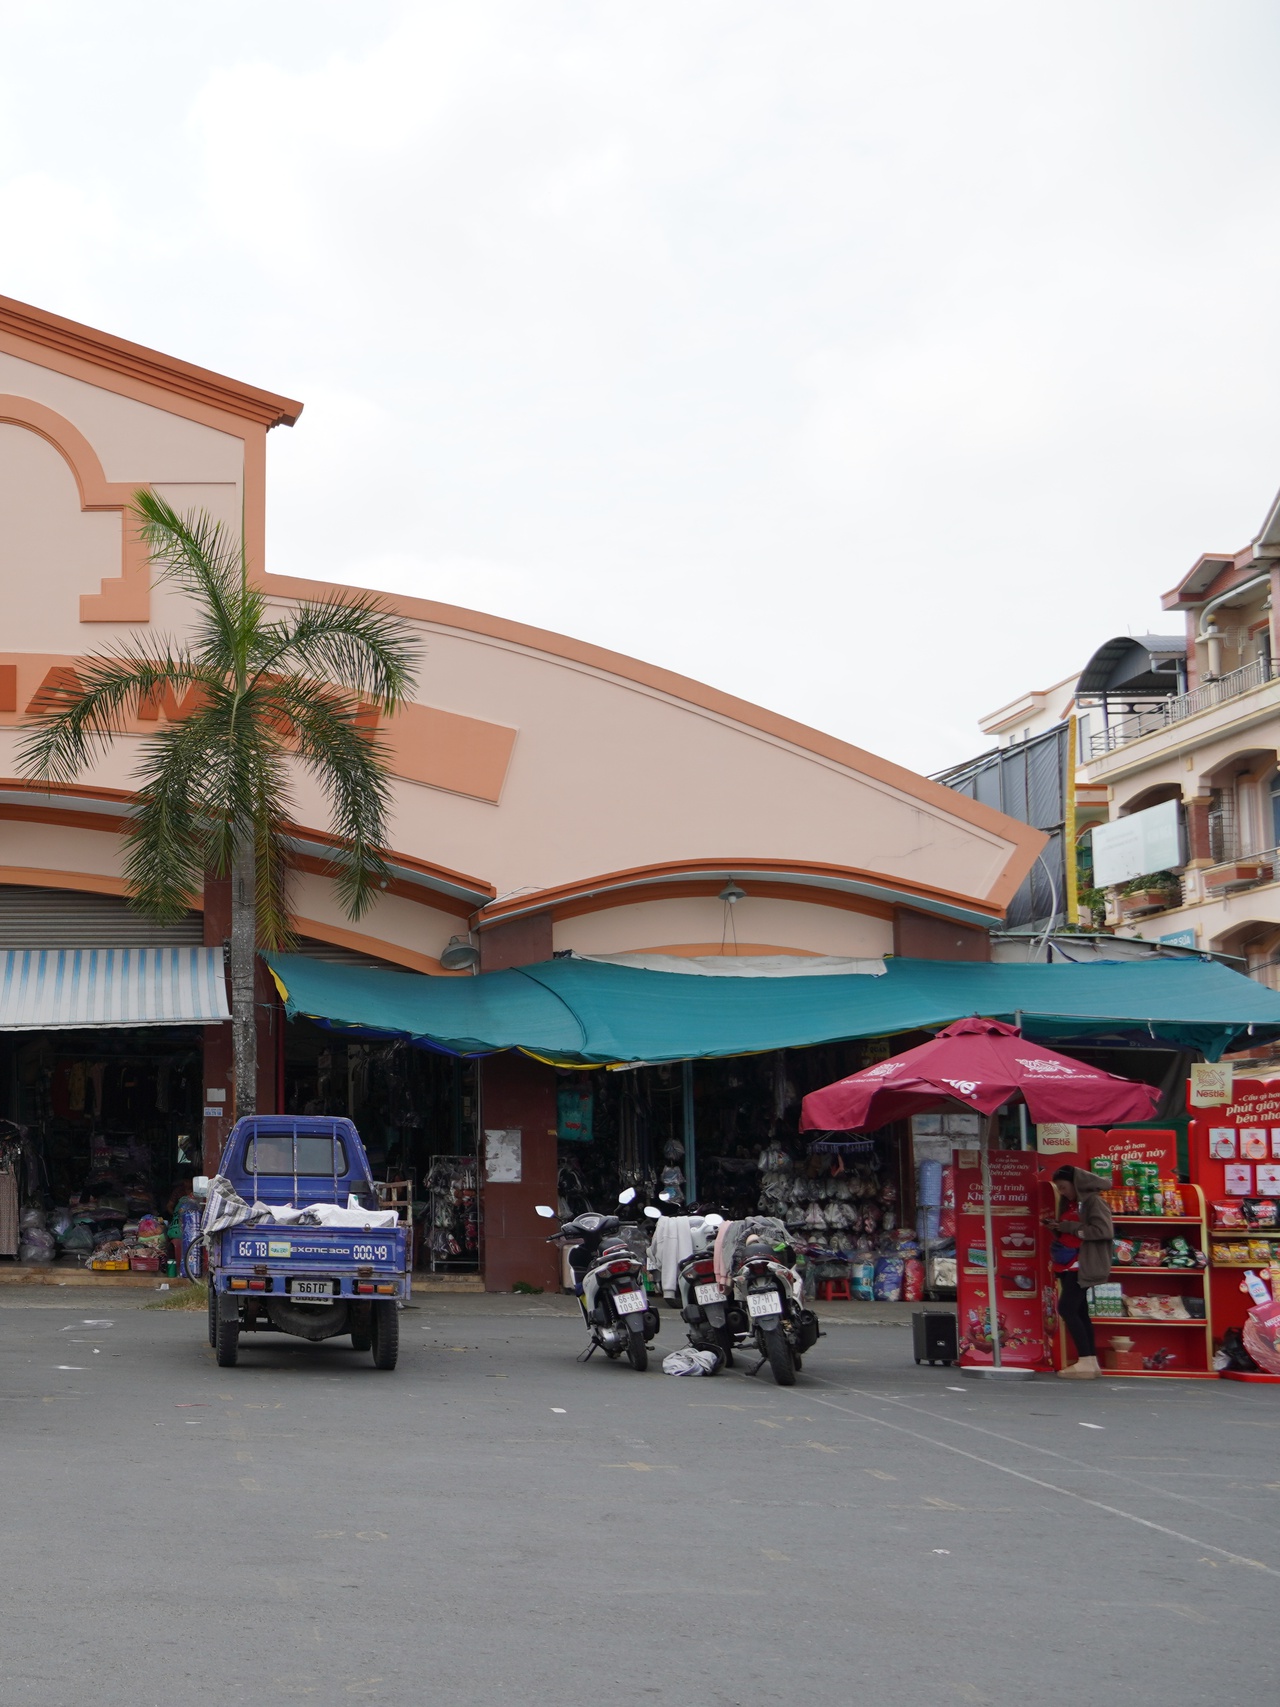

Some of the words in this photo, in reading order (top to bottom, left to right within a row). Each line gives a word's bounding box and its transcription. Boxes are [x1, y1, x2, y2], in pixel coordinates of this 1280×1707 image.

[1226, 1102, 1253, 1116] phút
[1235, 1112, 1258, 1124] bên
[1003, 1183, 1025, 1191] trình
